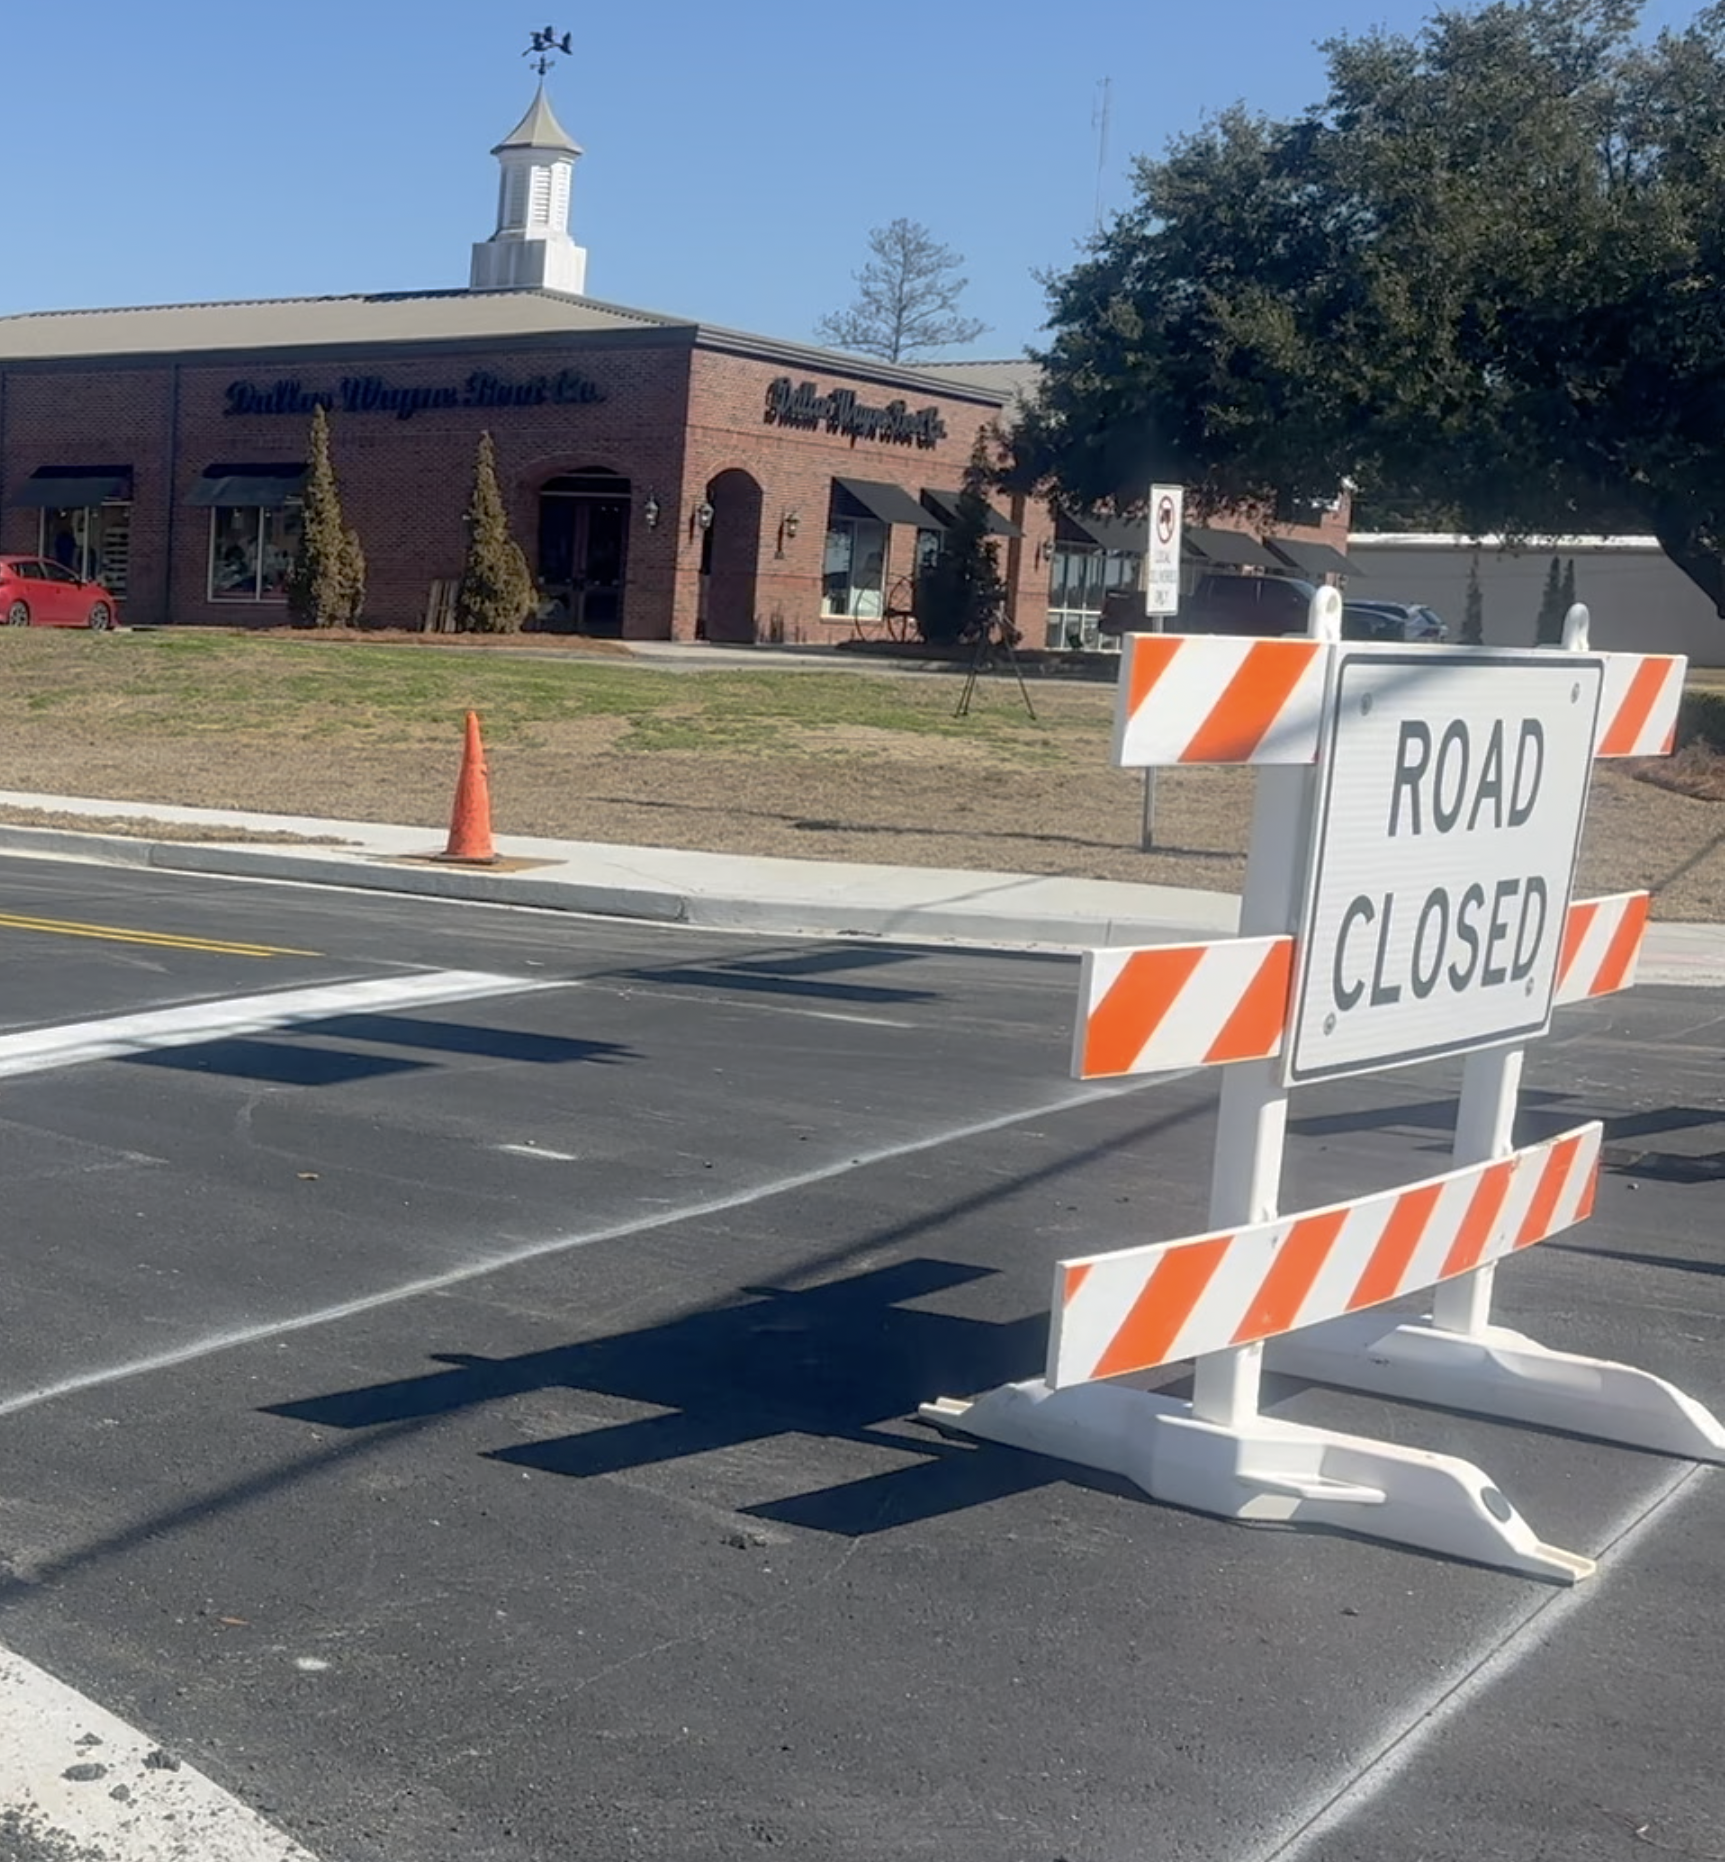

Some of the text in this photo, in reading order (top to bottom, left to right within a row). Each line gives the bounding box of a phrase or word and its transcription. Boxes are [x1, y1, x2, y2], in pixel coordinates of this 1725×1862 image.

[223, 379, 333, 416] Dallas
[341, 376, 459, 420] Wayne
[463, 370, 548, 407] Boot
[1388, 718, 1544, 837] ROAD
[1332, 875, 1548, 1012] CLOSED
